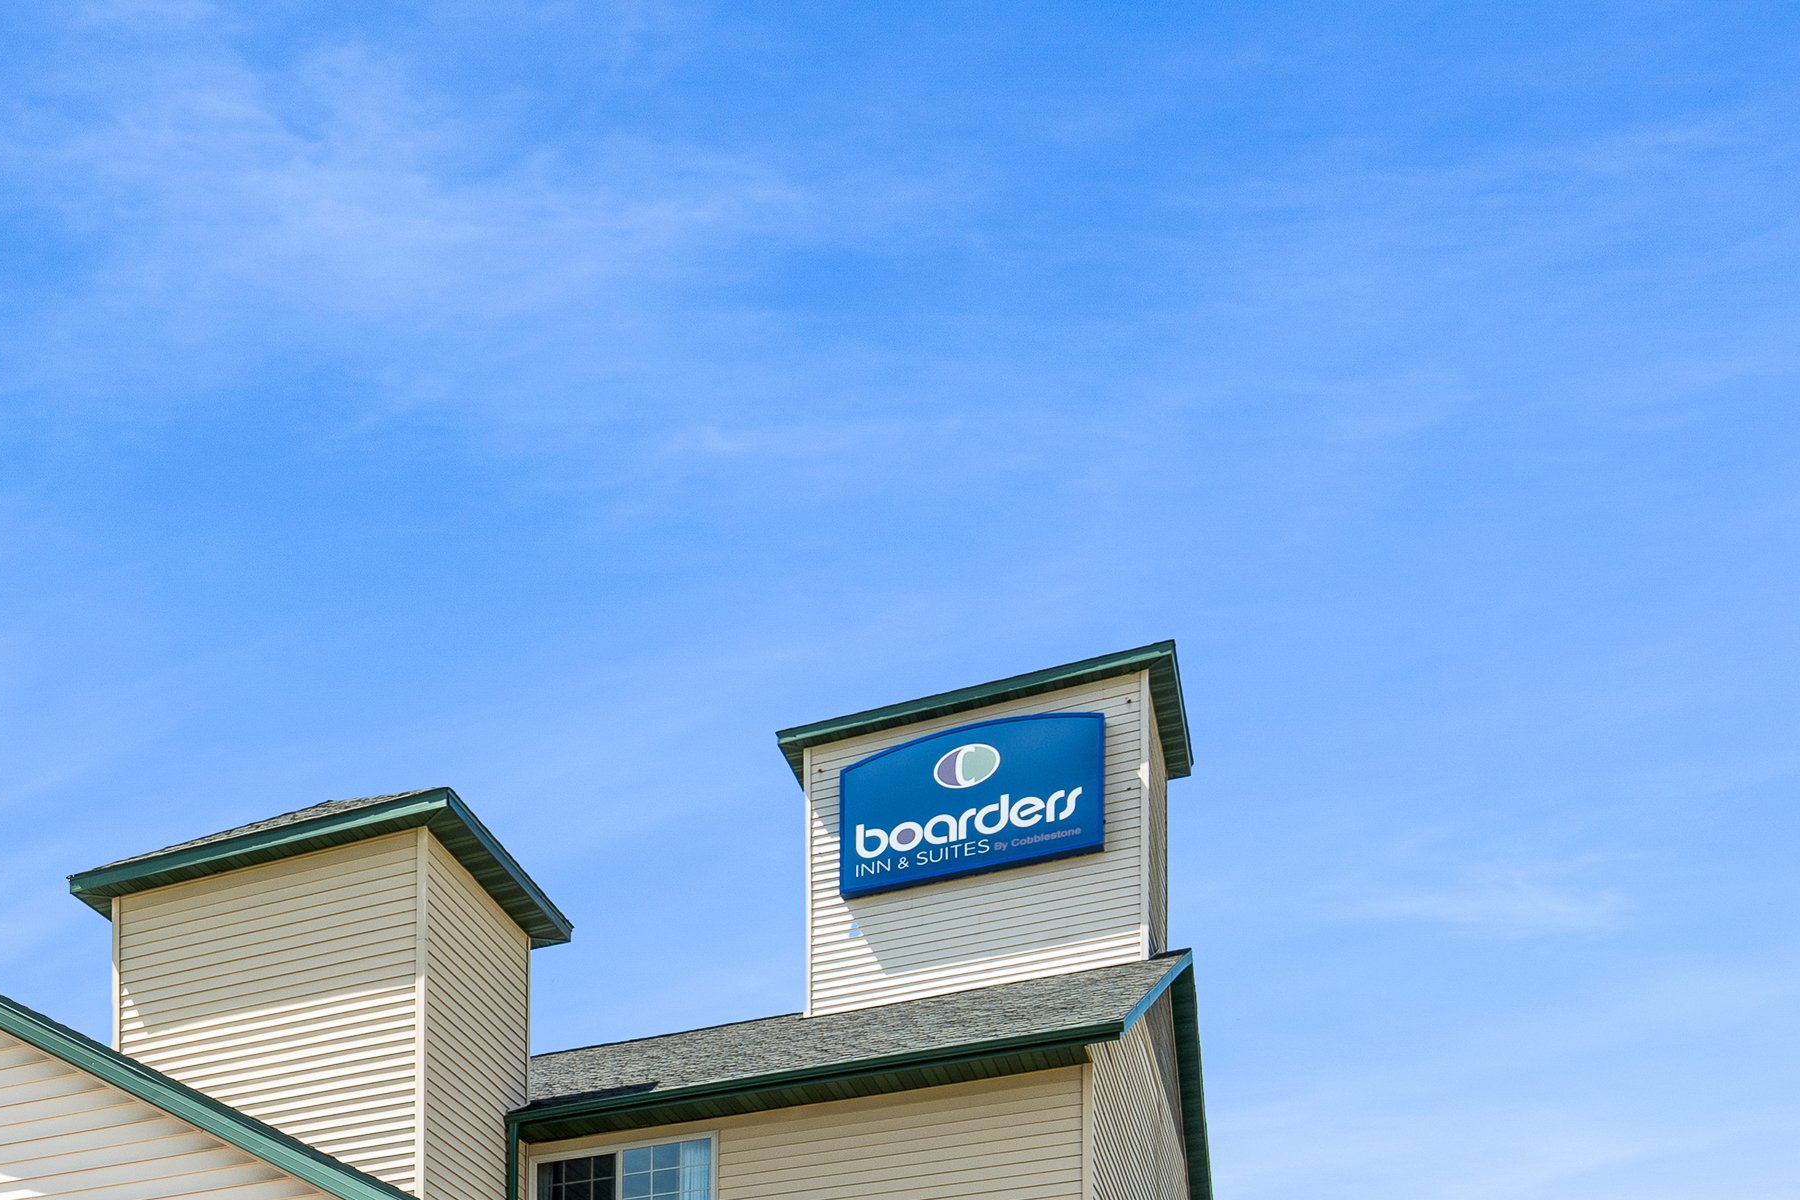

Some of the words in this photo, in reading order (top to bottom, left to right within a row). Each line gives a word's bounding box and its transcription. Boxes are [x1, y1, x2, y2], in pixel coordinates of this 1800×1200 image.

[855, 786, 1083, 859] boarders
[855, 858, 891, 878] INN
[897, 856, 910, 870] &
[916, 839, 990, 866] SUITES
[994, 841, 1008, 851] By
[1011, 827, 1082, 847] Cobblestone
